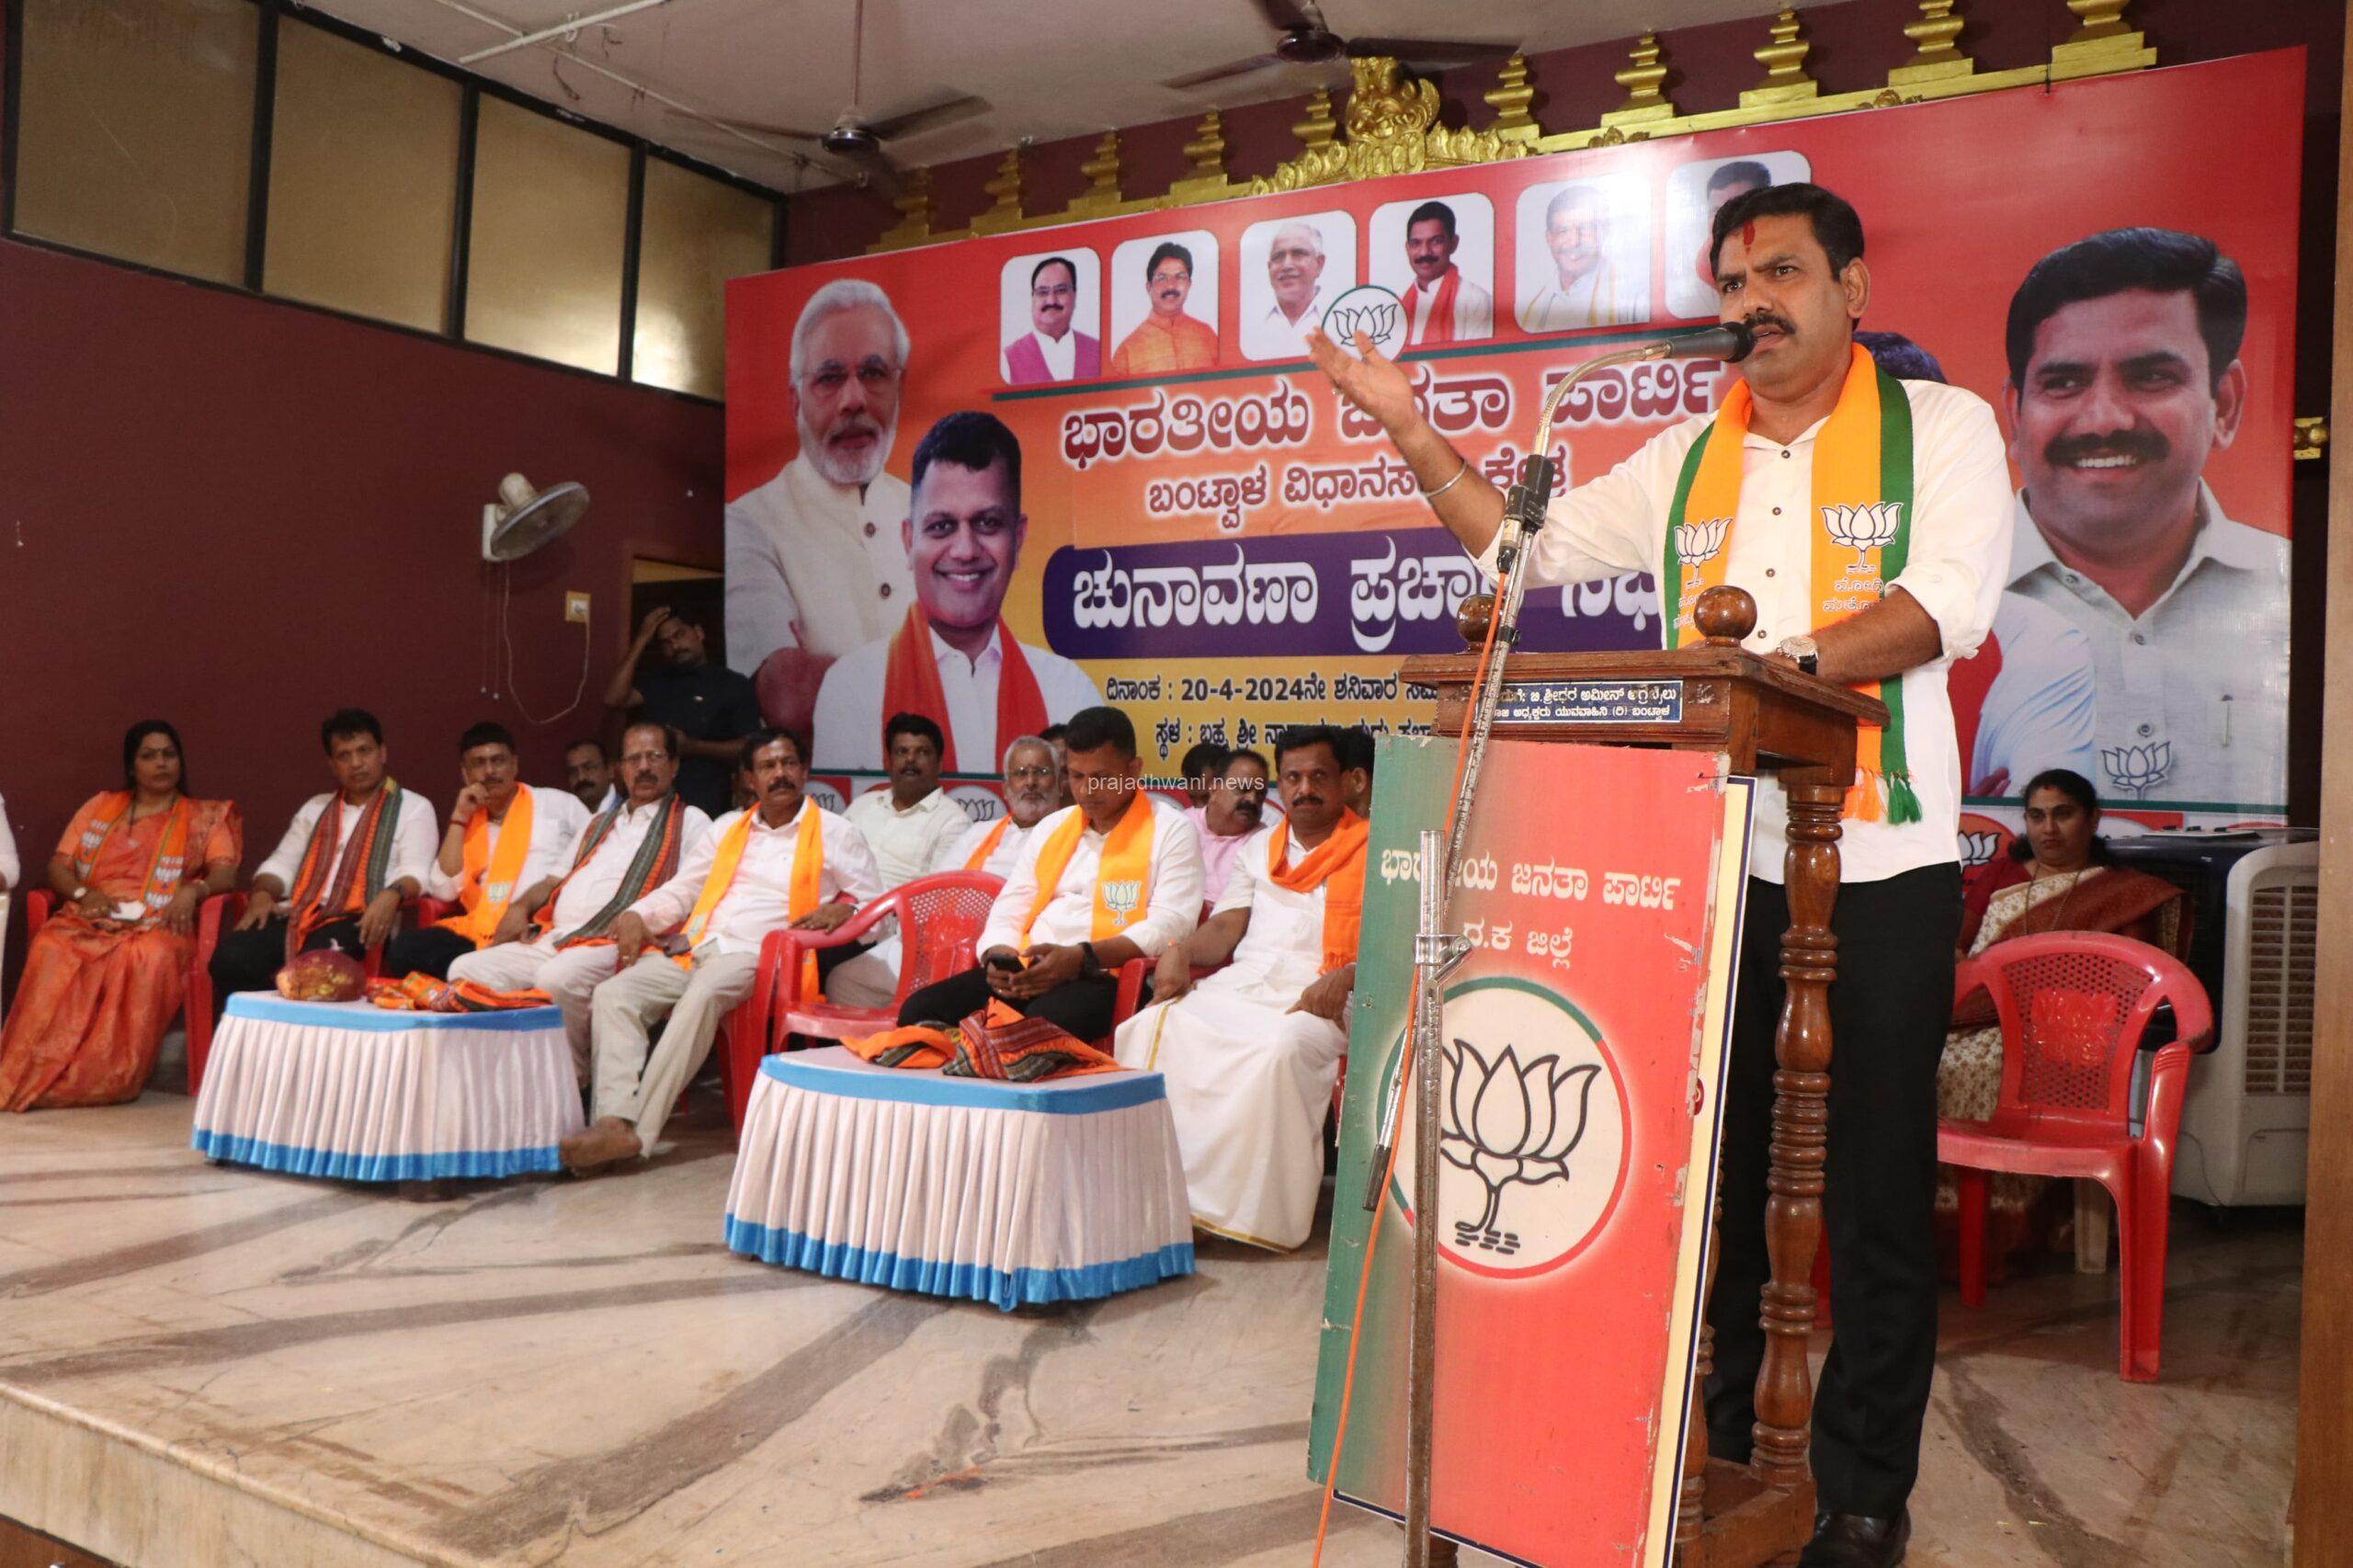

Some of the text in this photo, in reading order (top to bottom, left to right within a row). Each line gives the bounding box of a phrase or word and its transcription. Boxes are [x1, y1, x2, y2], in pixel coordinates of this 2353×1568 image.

[1064, 378, 1310, 470] ಭಾರತೀಯ
[1546, 359, 1722, 424] ಪಾರ್ಟಿ
[1149, 457, 1417, 529] ಬಂಟ್ವಾಳ ವಿಧಾನಸ
[1073, 542, 1319, 629] ಚುನಾವಣಾ
[1107, 675, 1161, 700] ದಿನಾಂಕ
[1181, 672, 1326, 700] 20-4-2024ನೇ
[1334, 672, 1398, 700] ಶನಿವಾರ
[1511, 855, 1589, 901] ಜನತಾ
[1602, 870, 1681, 911] ಪಾರ್ಟಿ
[1526, 926, 1574, 970] ಜಿಲ್ಲೆ
